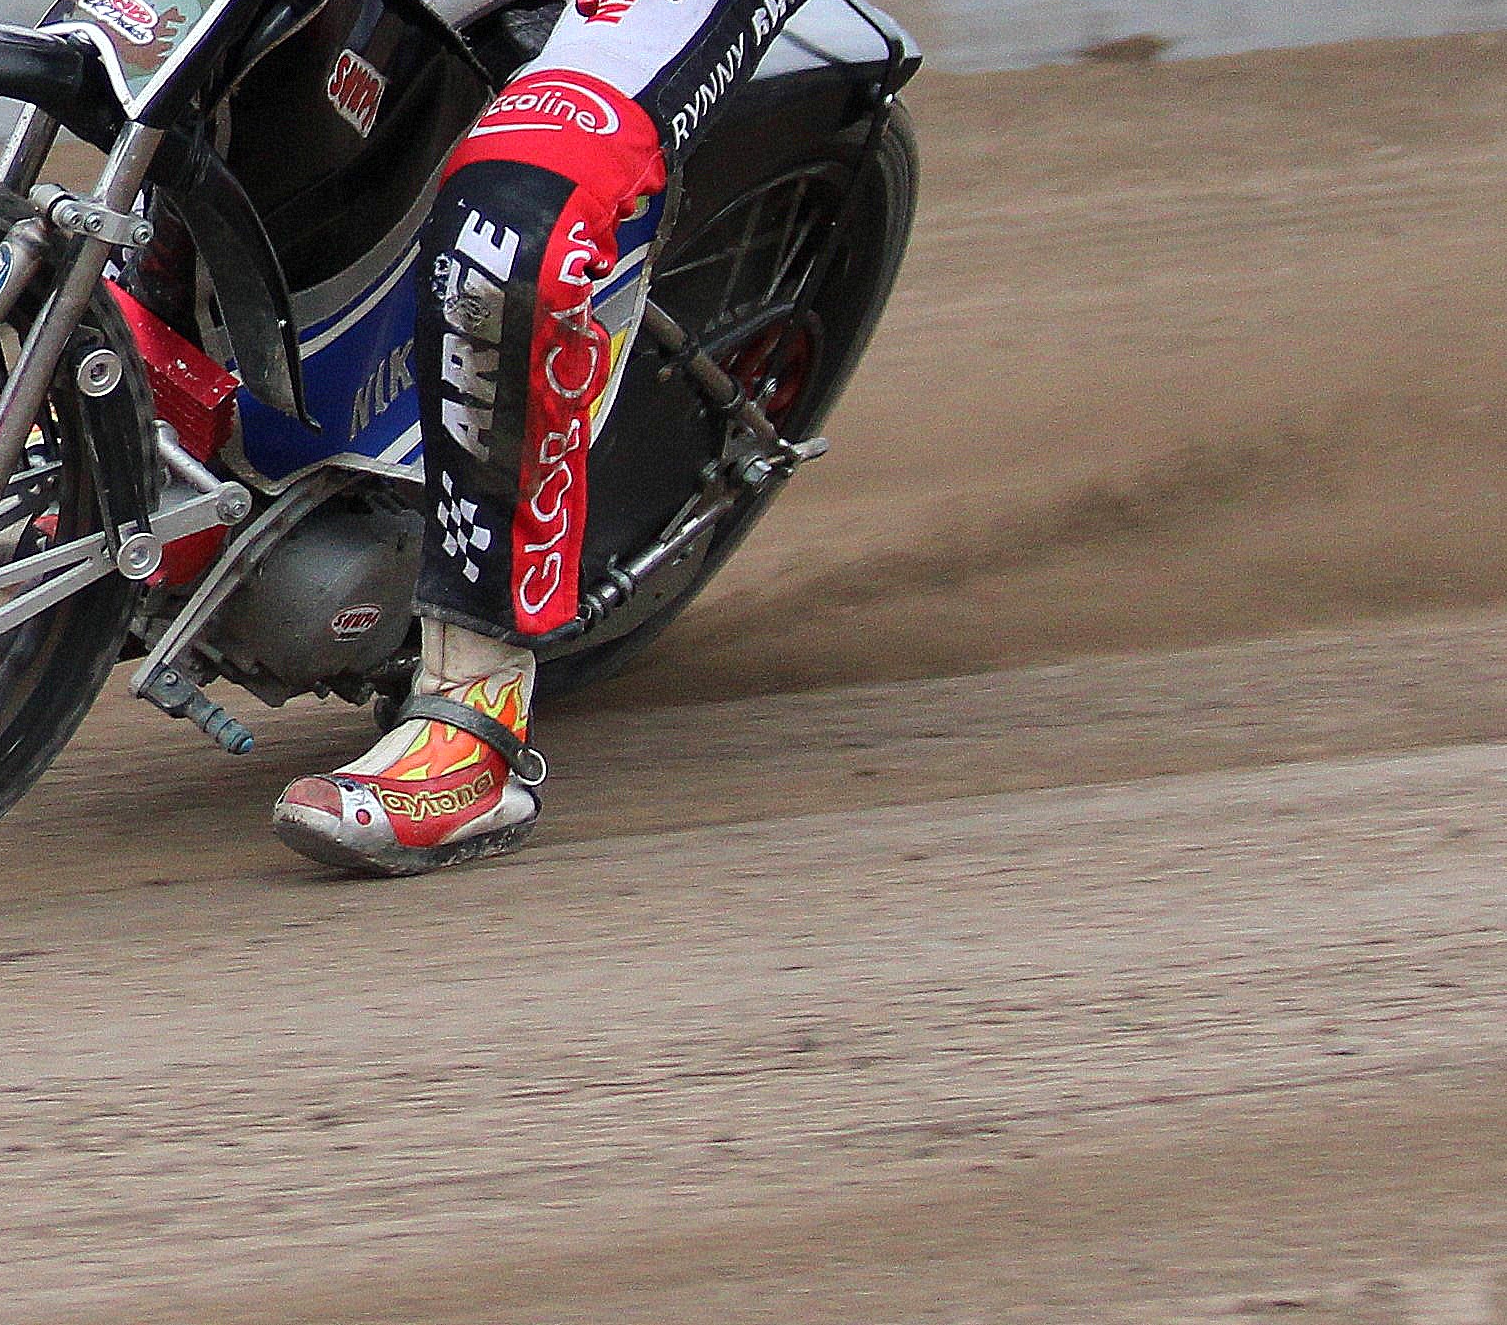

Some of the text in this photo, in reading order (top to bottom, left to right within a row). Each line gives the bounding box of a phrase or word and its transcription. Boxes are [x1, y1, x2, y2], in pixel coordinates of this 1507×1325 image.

[485, 91, 598, 132] Ecoline
[671, 33, 745, 151] RYNNY
[518, 419, 581, 616] GLOB
